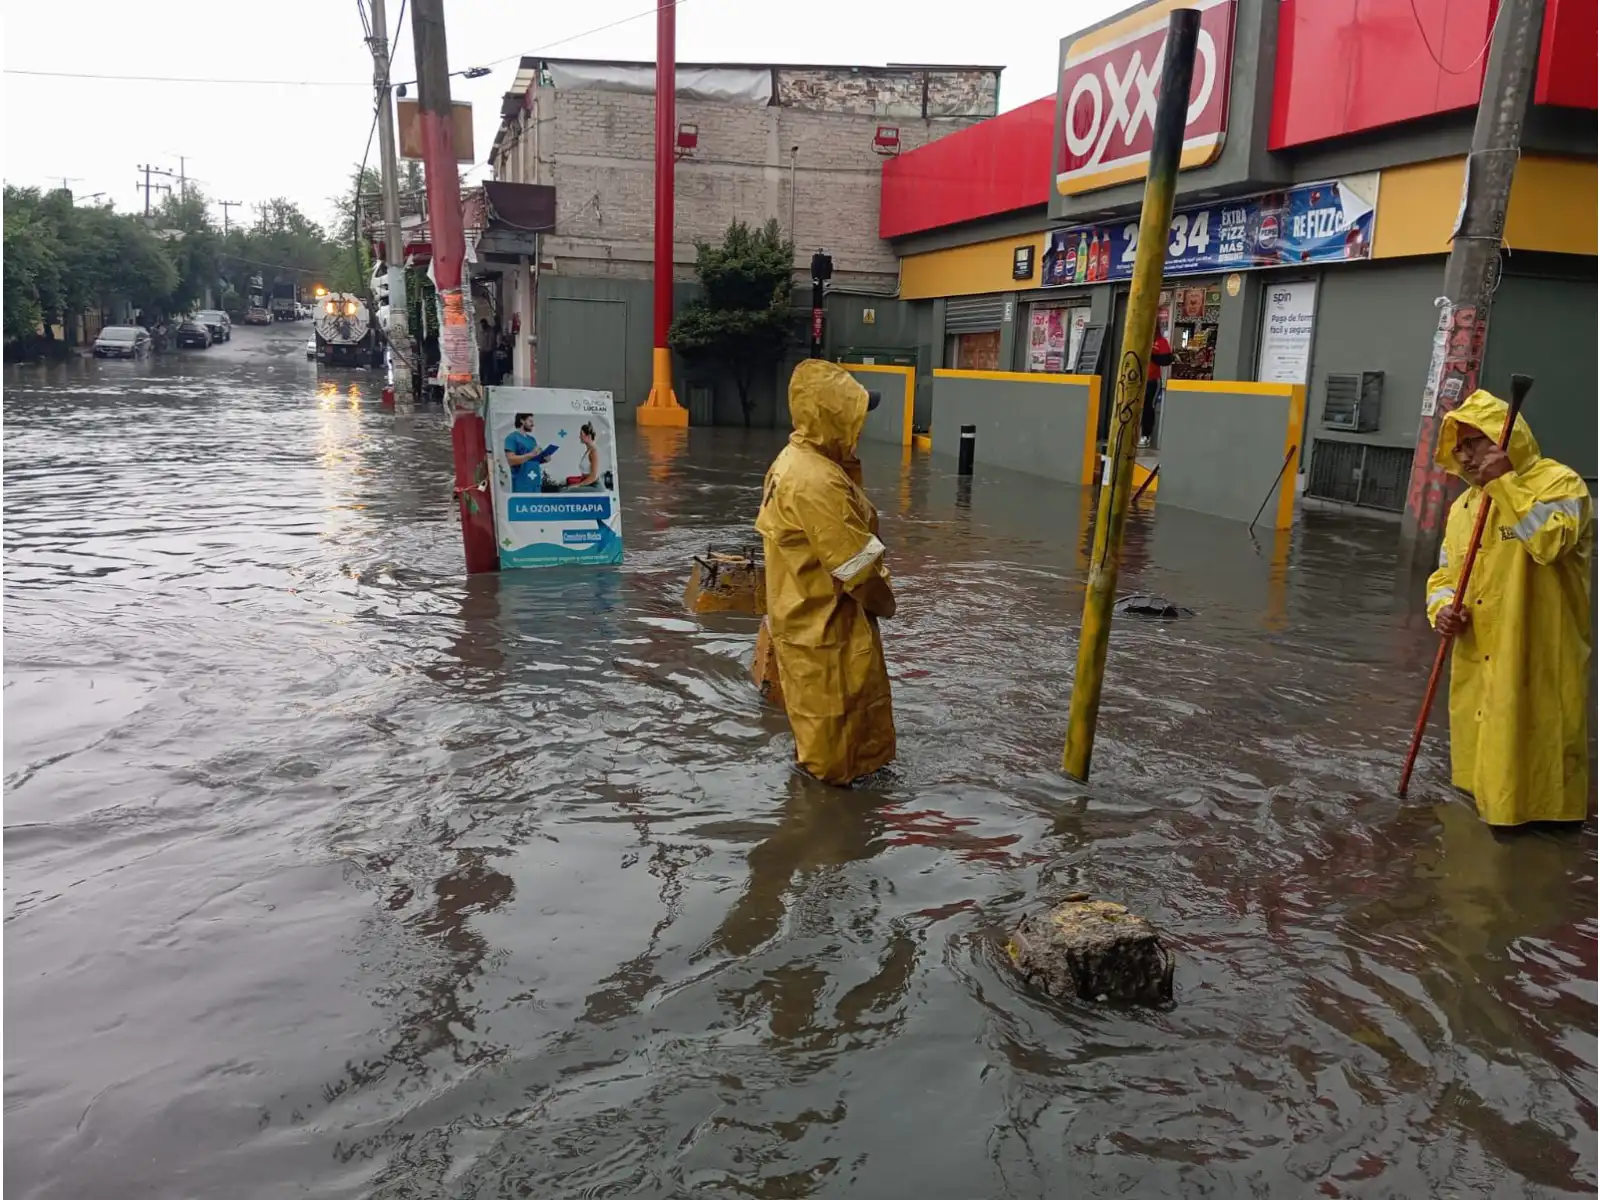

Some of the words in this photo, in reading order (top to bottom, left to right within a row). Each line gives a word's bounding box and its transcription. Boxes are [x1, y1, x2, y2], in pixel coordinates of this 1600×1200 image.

[1219, 241, 1245, 253] MÁS
[1272, 291, 1291, 304] spin
[1271, 314, 1287, 324] Paga
[1287, 313, 1297, 322] de
[515, 504, 528, 513] LA
[530, 503, 604, 513] OZONOTERAPIA
